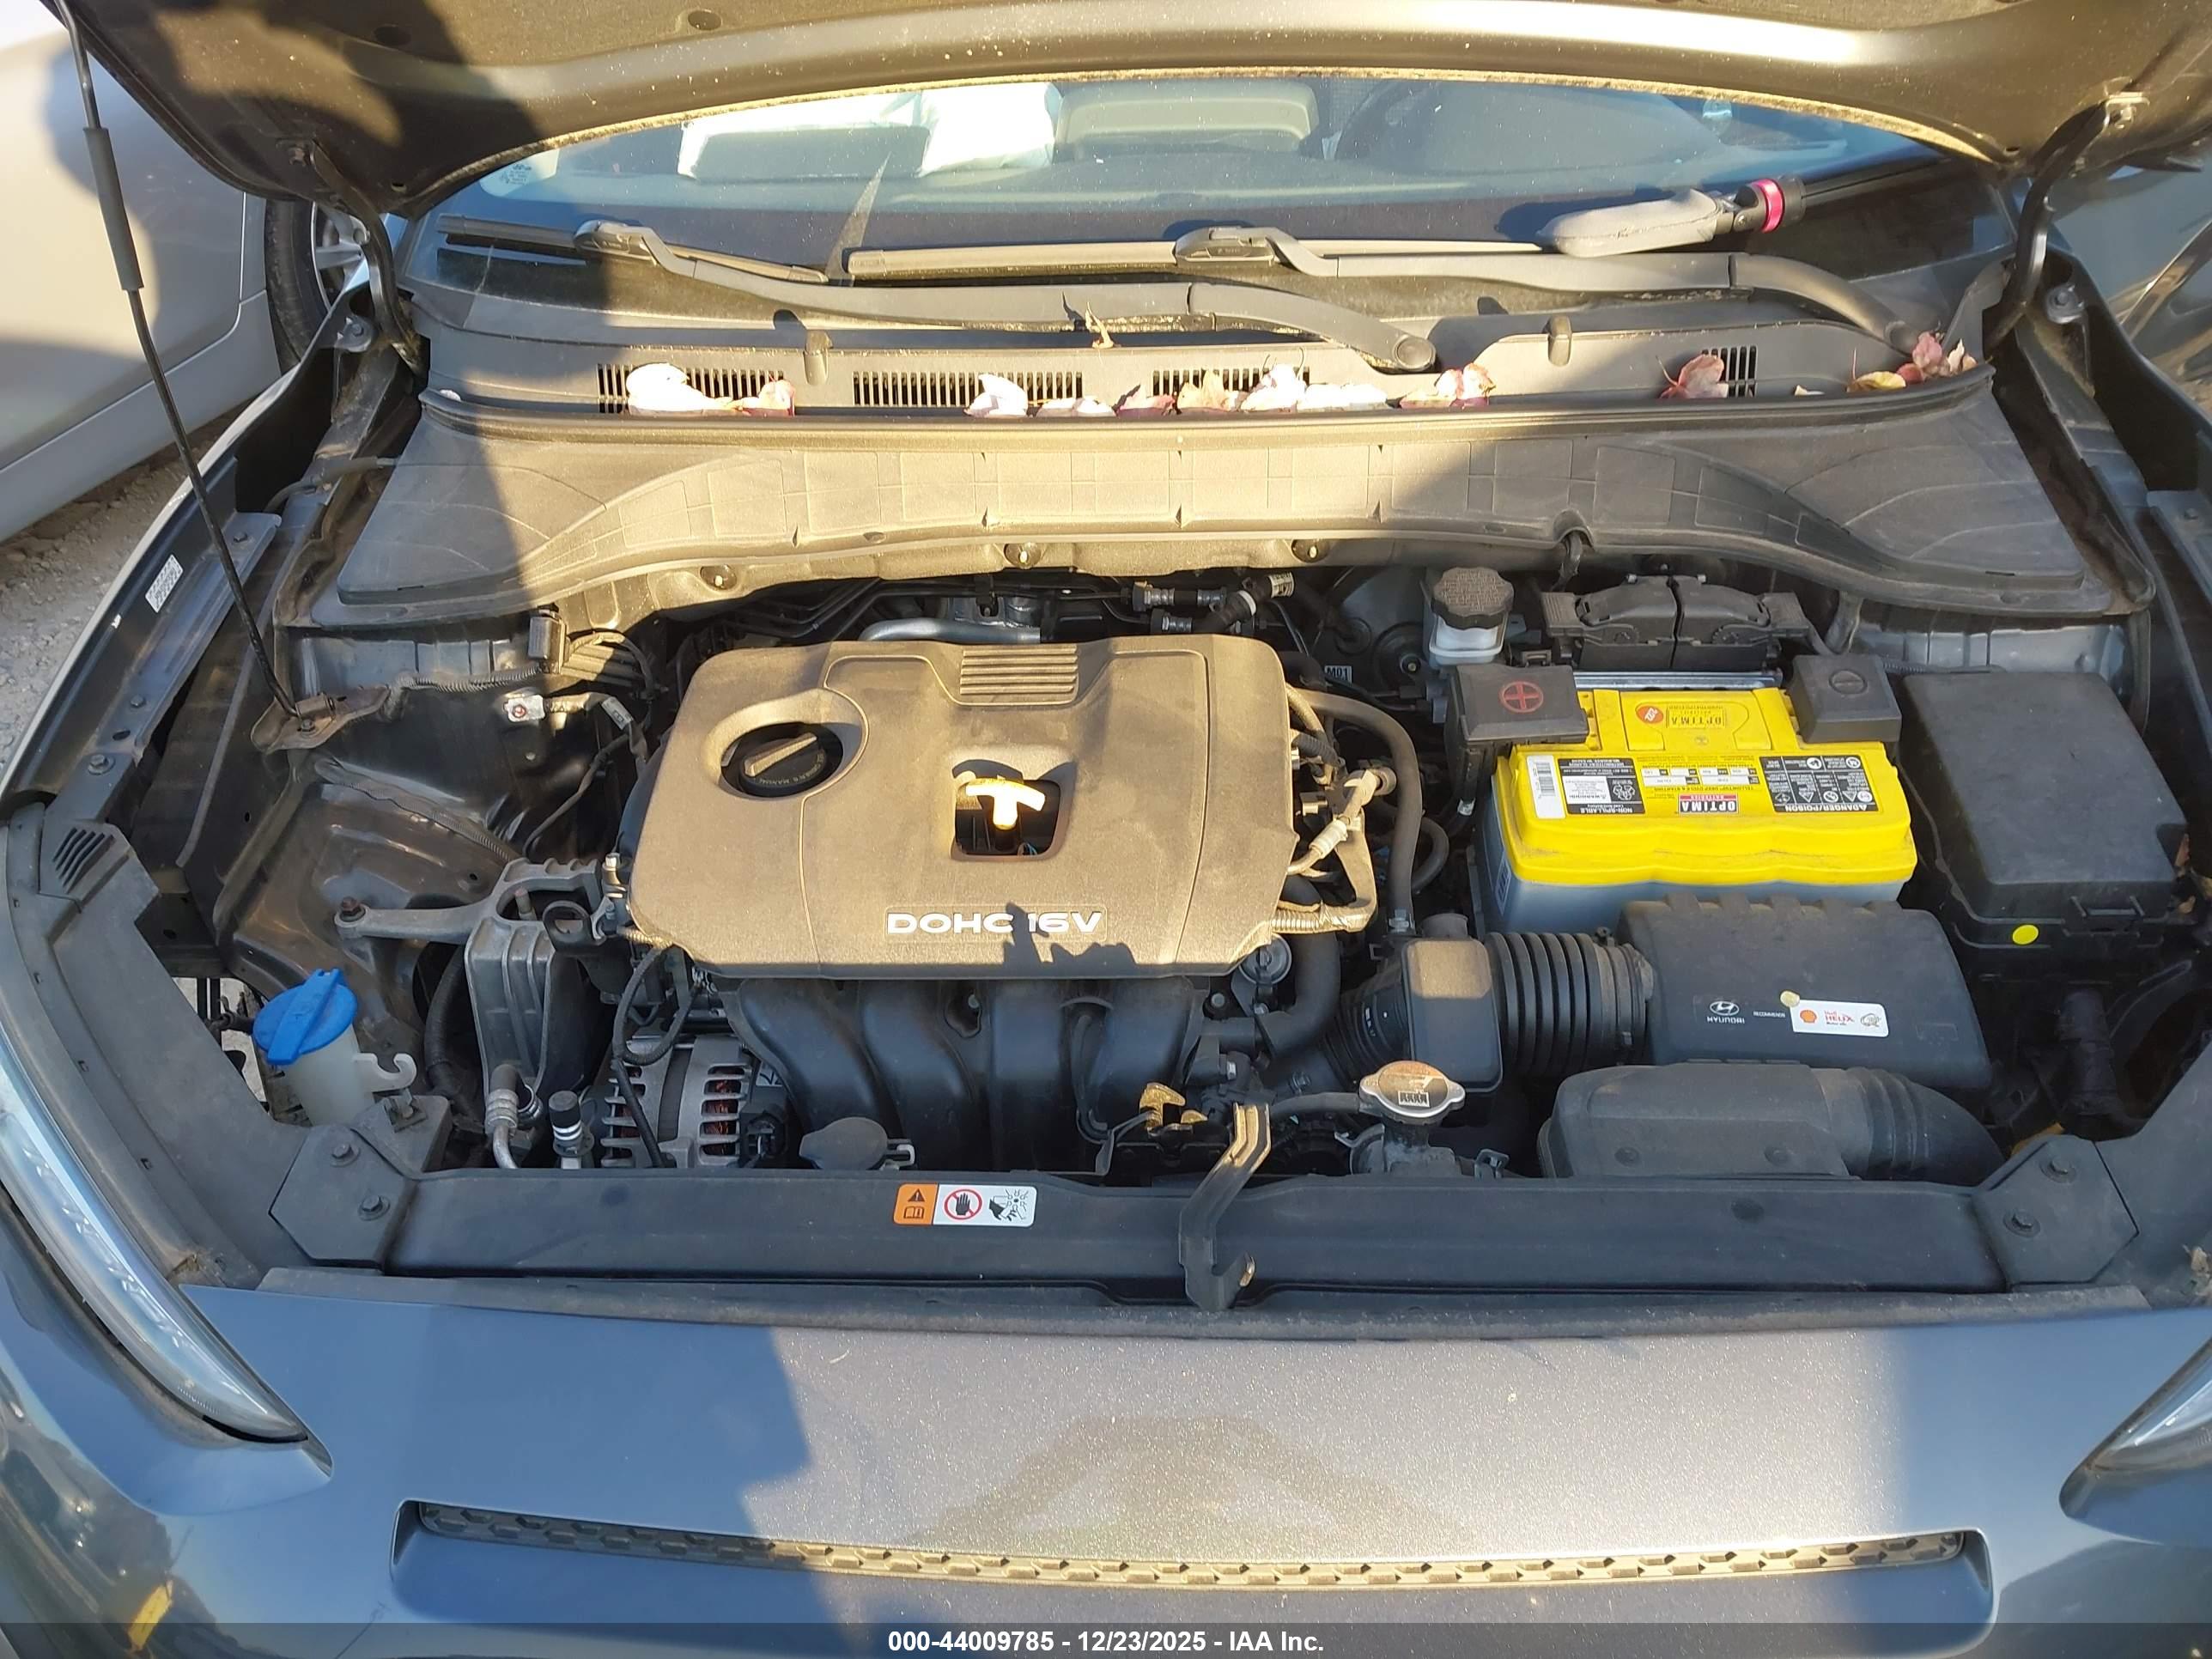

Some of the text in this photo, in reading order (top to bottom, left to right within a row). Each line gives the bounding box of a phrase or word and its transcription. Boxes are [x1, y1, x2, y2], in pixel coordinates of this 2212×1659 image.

[1671, 716, 1722, 725] OPTIMA
[1681, 800, 1735, 811] OPTIMA
[887, 911, 1103, 934] DOHC 16V
[1706, 1016, 1745, 1024] HYUNDAI
[1825, 1013, 1855, 1022] HELIX
